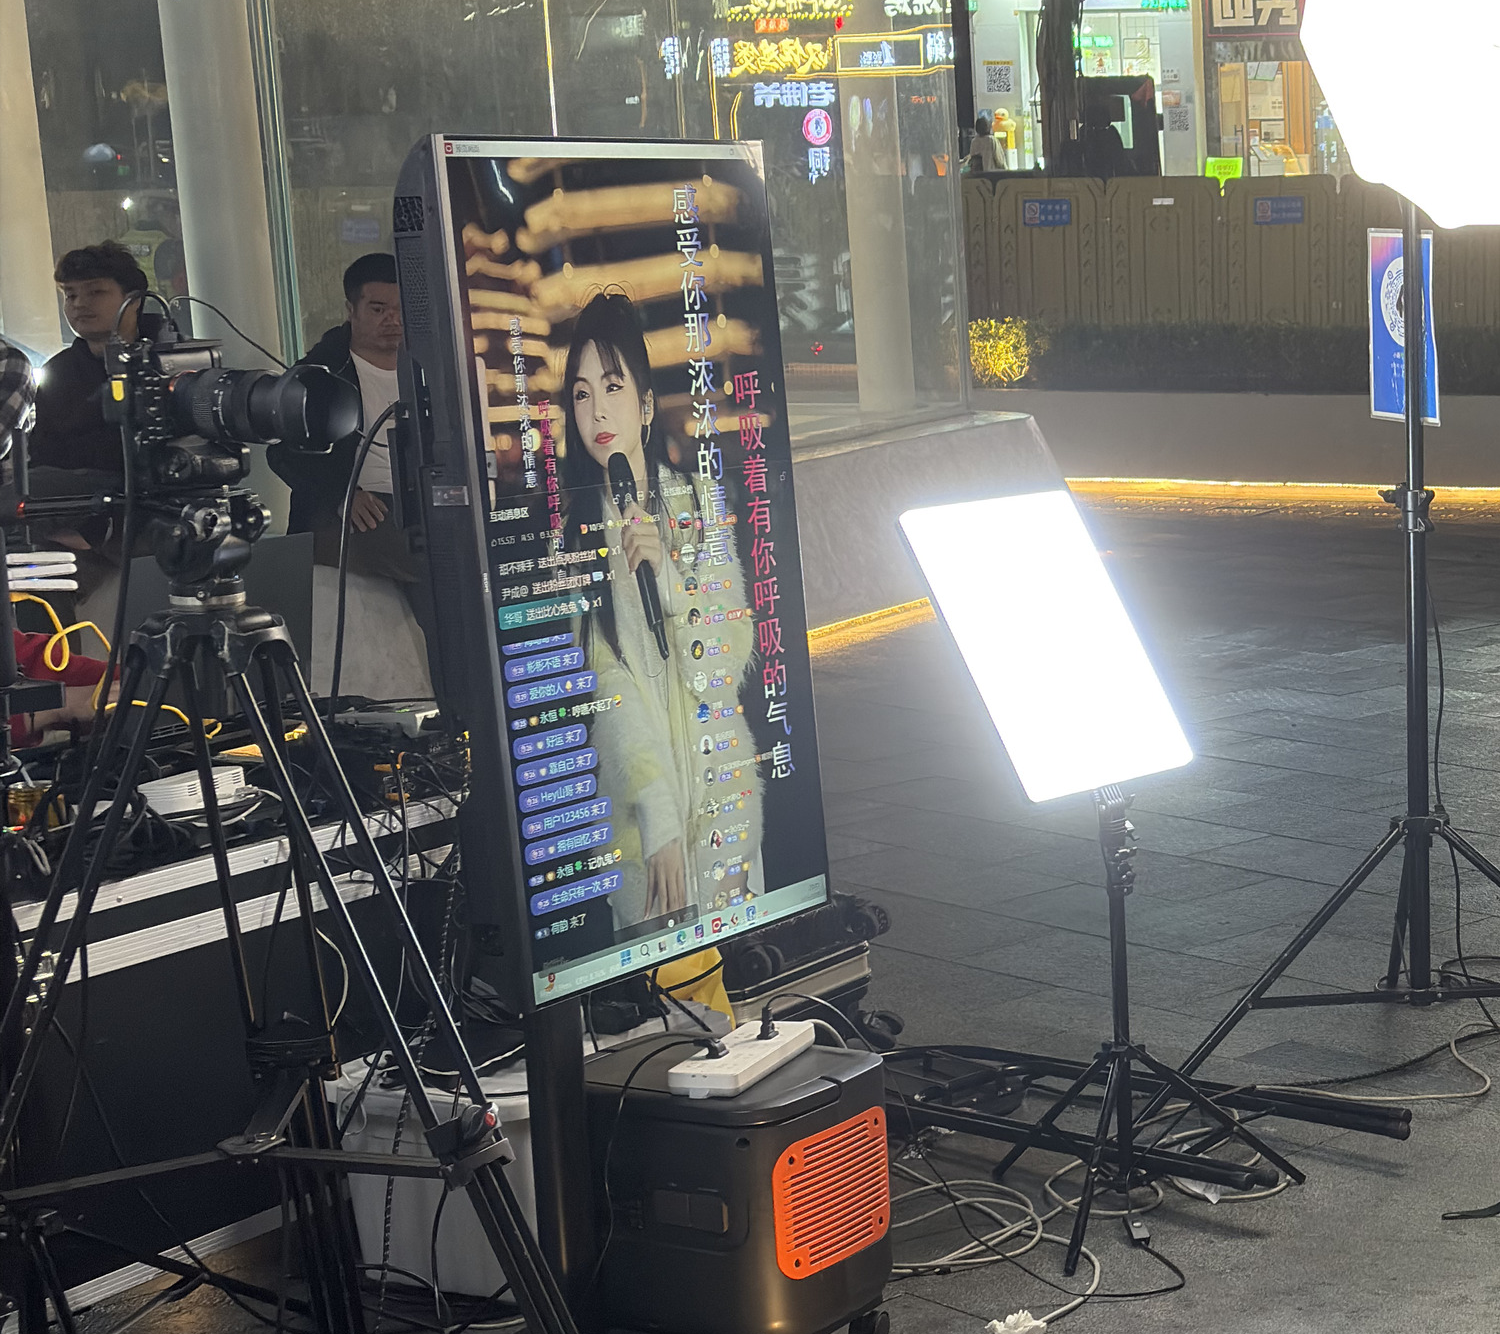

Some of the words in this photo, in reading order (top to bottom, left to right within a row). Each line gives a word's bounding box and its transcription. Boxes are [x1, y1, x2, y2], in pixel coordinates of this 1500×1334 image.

[672, 184, 733, 568] 感受你那浓浓的情意
[508, 317, 538, 490] 感受你那浓浓的情意
[733, 370, 796, 780] 呼吸着有你呼吸的气息
[562, 652, 580, 666] 来了
[576, 675, 593, 690] 来了
[539, 710, 559, 724] 永恒
[545, 733, 565, 749] 好运
[565, 729, 582, 743] 来了
[576, 753, 593, 768] 来了
[574, 780, 592, 794] 来了
[543, 808, 590, 830] 用户123456
[591, 802, 608, 816] 来了
[592, 827, 609, 843] 来了
[556, 864, 575, 879] 永恒
[551, 881, 602, 906] 生命只有一次
[602, 875, 619, 889] 来了
[569, 913, 587, 929] 来了
